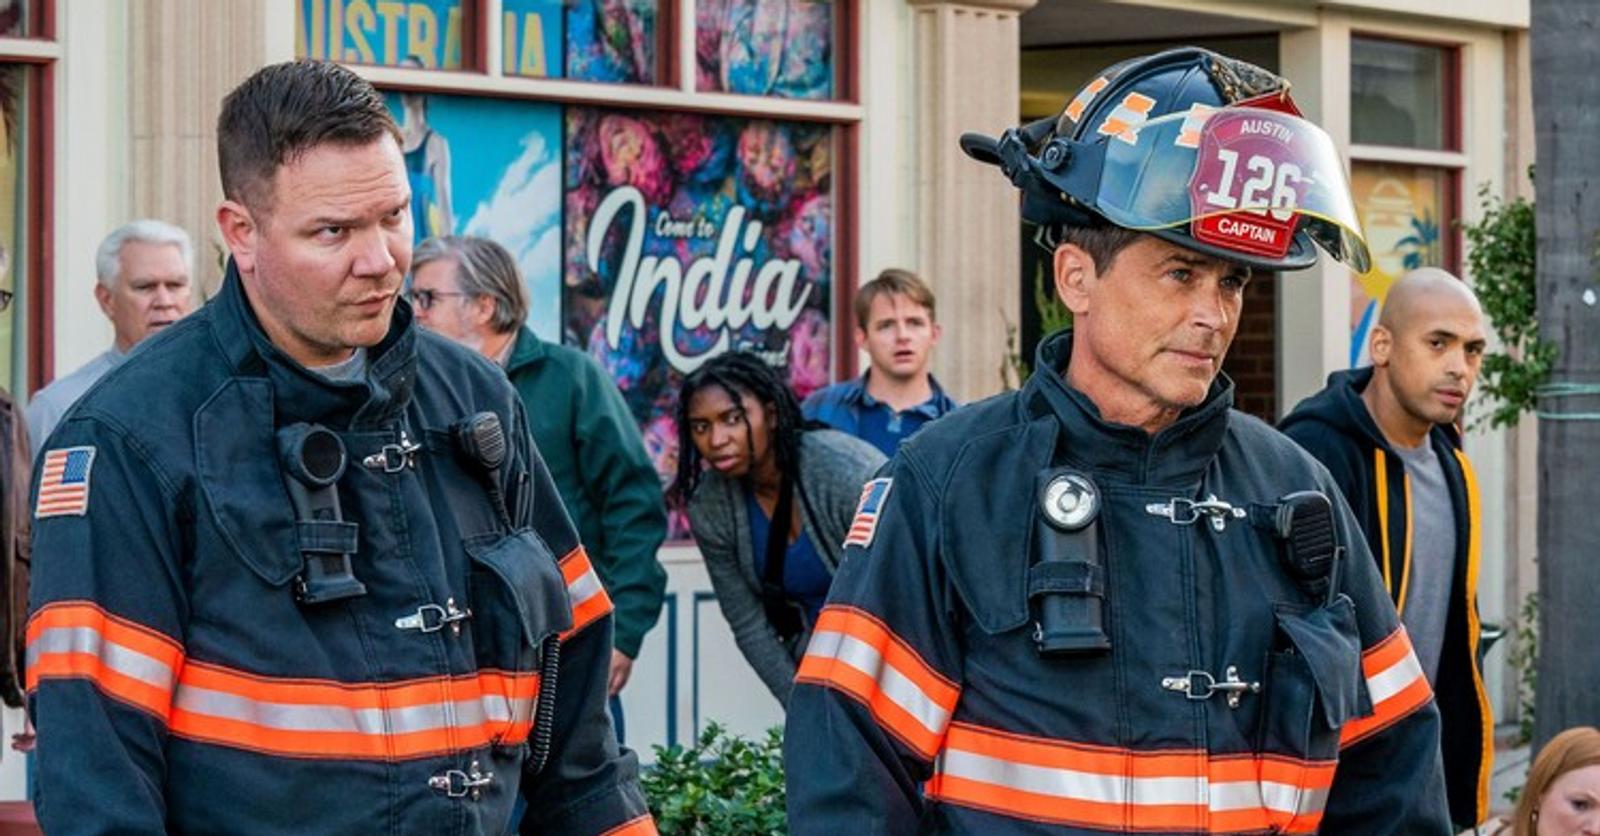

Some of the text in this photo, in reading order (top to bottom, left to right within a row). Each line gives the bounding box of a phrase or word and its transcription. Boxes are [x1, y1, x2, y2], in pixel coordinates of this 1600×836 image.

[295, 0, 548, 76] USTRAIA
[1240, 119, 1295, 143] AUSTIN
[1206, 149, 1301, 222] 126
[655, 211, 715, 238] Come to
[1217, 218, 1276, 243] CAPTAIN
[588, 186, 813, 374] India
